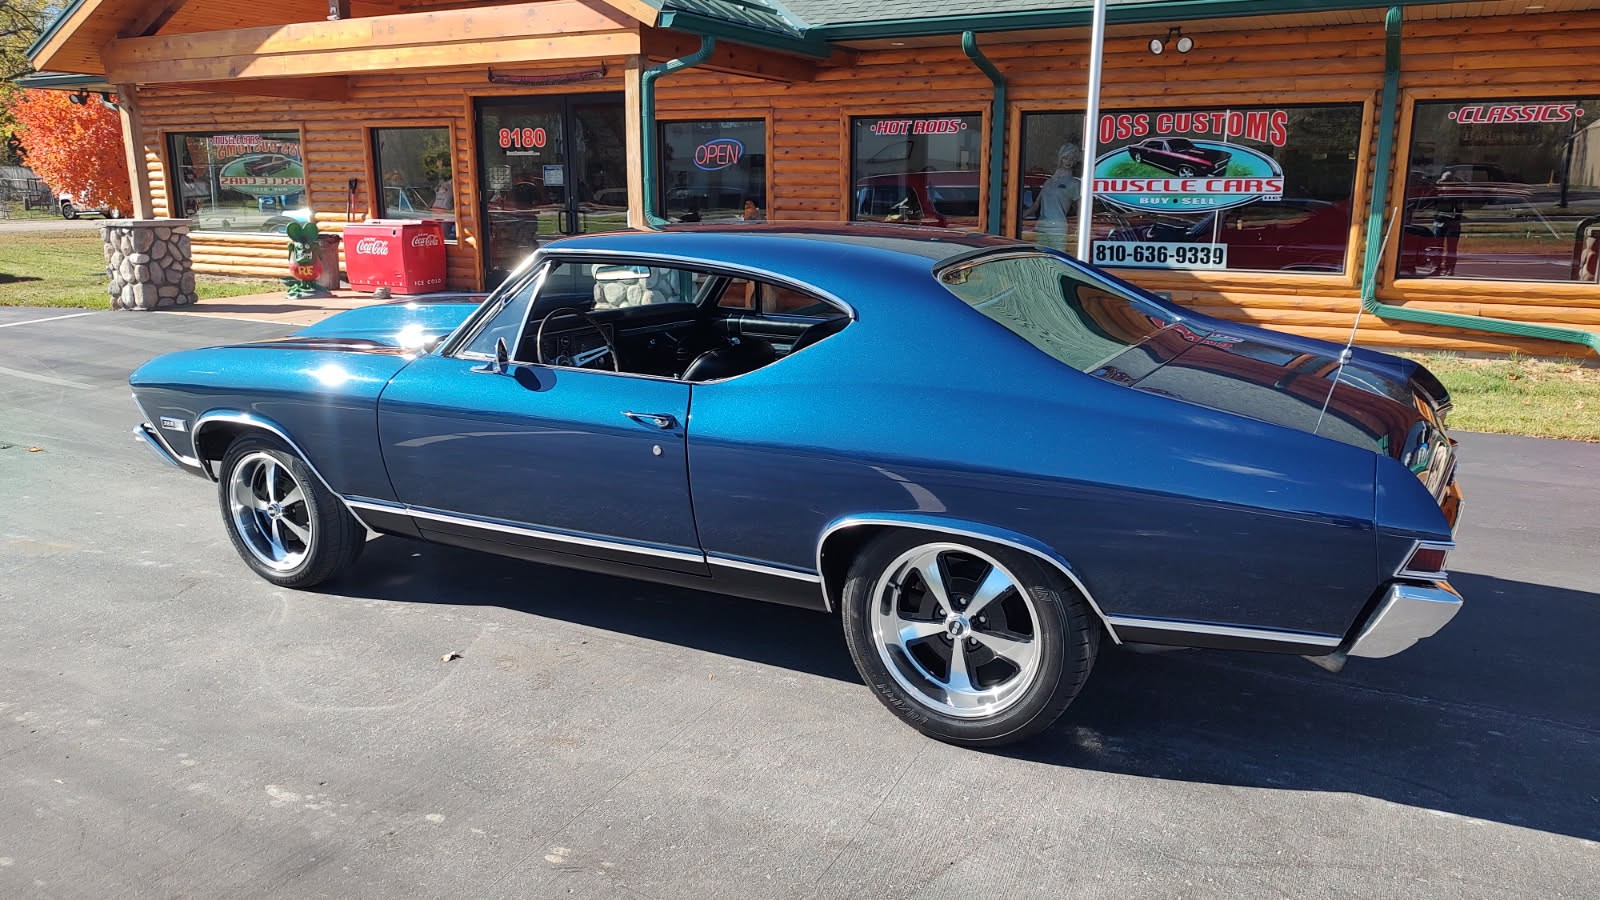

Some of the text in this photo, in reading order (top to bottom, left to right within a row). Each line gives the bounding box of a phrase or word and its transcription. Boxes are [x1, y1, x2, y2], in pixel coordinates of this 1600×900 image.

[1457, 104, 1576, 123] CLASSICS
[876, 119, 961, 135] HOT RODS
[1083, 111, 1288, 147] OSS CUSTOMS
[213, 135, 260, 146] MUSCLE CARS
[499, 128, 546, 148] 8180
[695, 144, 739, 165] OPEN
[1093, 179, 1282, 192] MUSCLE CARS
[1181, 197, 1216, 205] SELL
[1096, 244, 1224, 265] 810-636-9339
